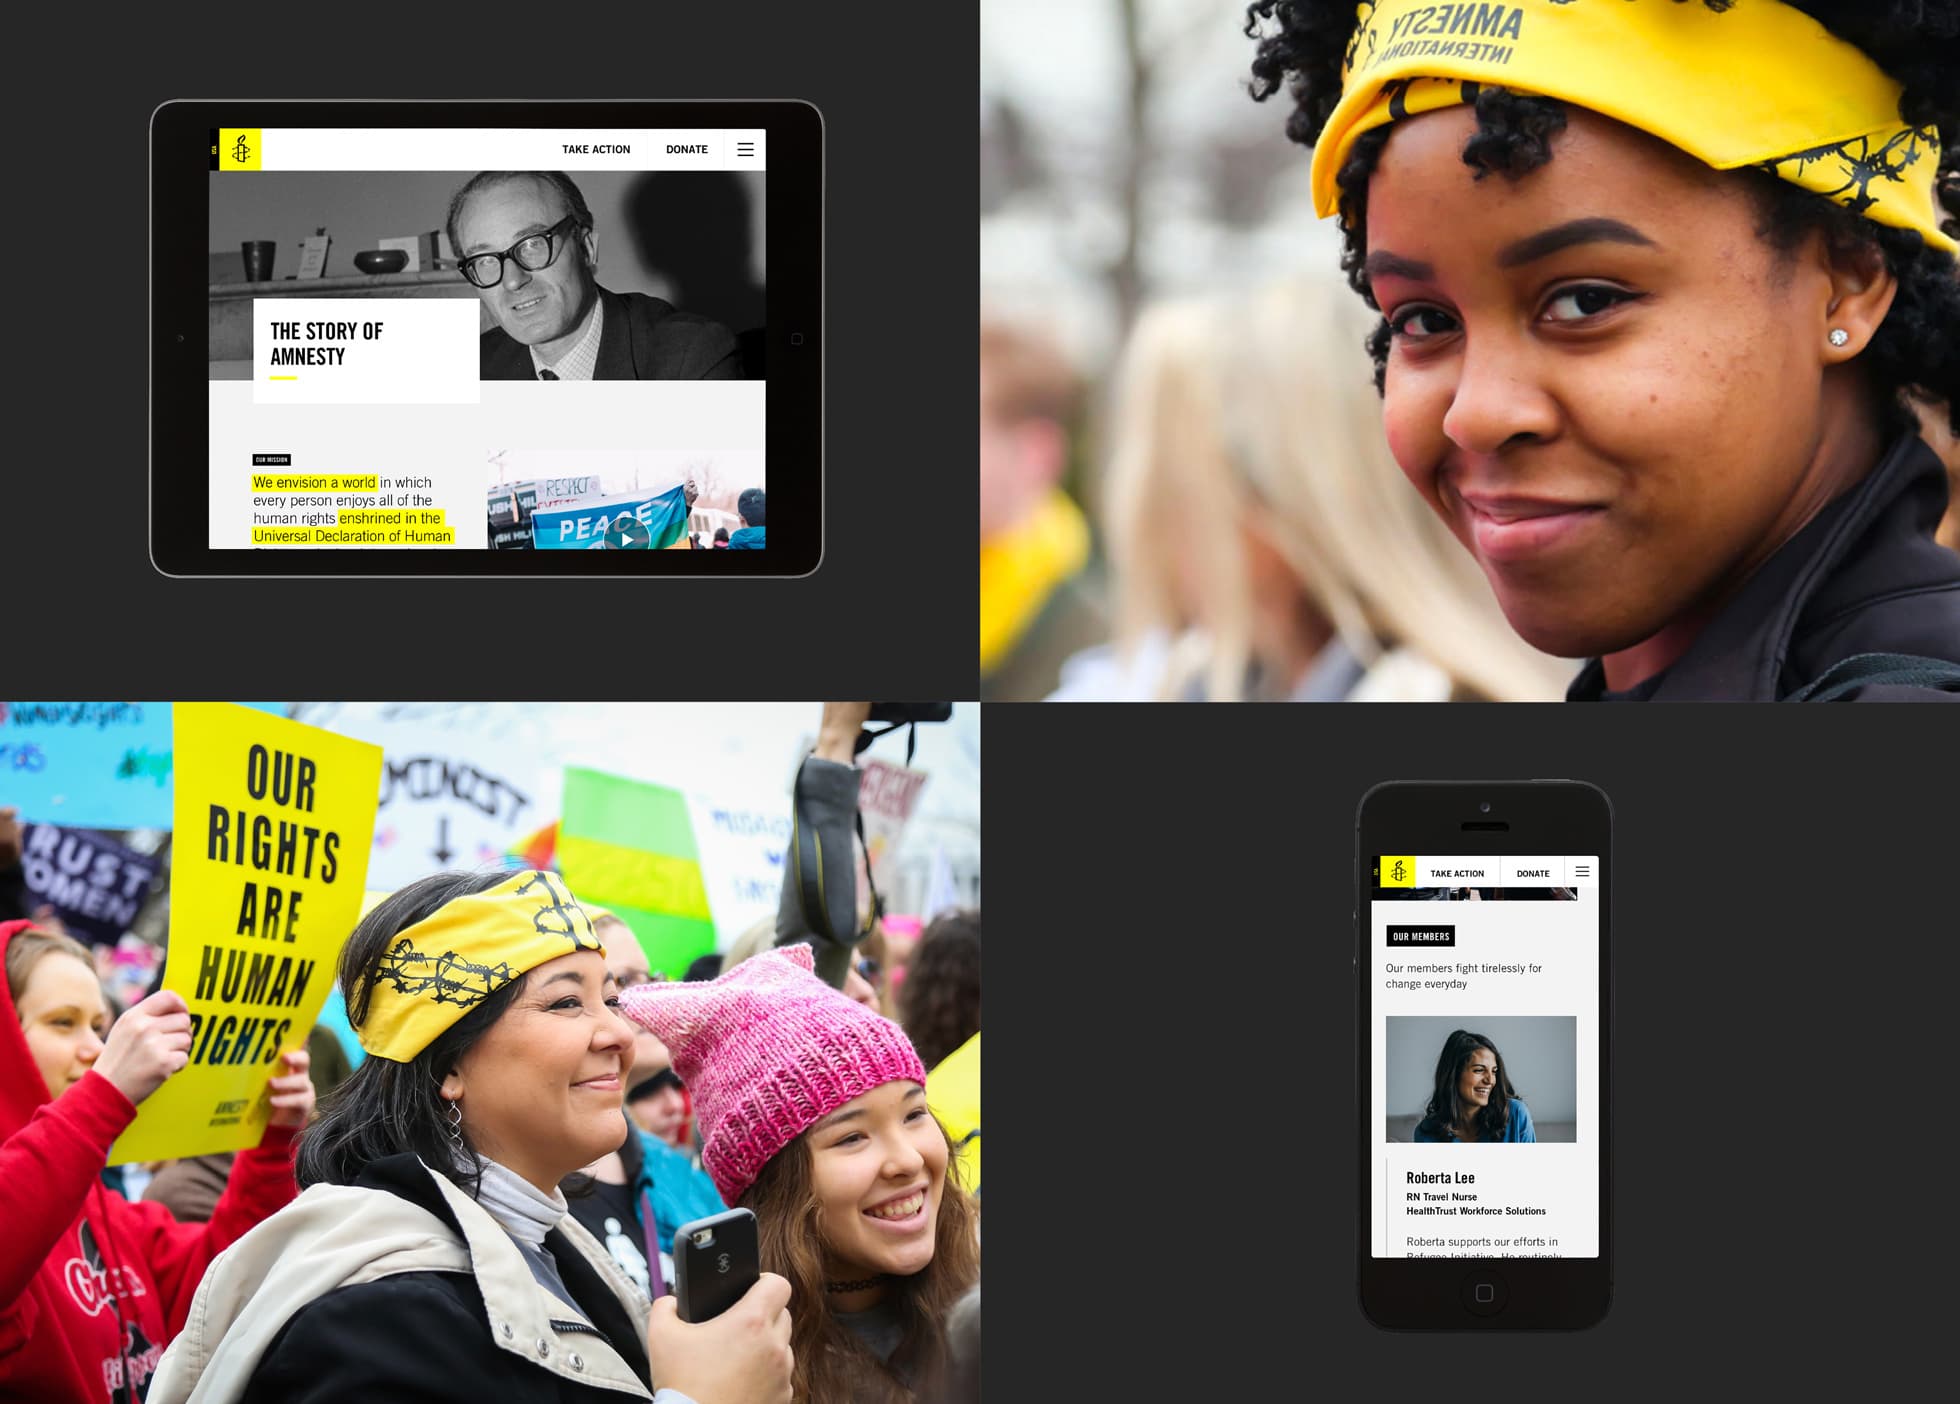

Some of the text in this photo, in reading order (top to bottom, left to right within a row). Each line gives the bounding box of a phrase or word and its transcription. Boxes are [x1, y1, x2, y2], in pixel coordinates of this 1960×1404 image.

[562, 144, 631, 154] TAKE ACTION
[666, 144, 709, 154] DONATE
[270, 321, 384, 341] THE STORY OF
[270, 346, 346, 366] AMNESTY
[253, 476, 432, 489] We envision a world in which
[546, 477, 591, 497] RESPECT
[253, 494, 433, 509] every person enjoys all of the
[488, 501, 512, 515] USH
[253, 512, 441, 527] human rights enshrined in the
[560, 502, 653, 542] PEACE
[254, 529, 451, 542] Universal Declaration of Human
[247, 743, 317, 813] OUR
[207, 803, 341, 884] RIGHTS
[27, 824, 154, 898] RUST
[1430, 869, 1485, 878] TAKE ACTION
[1516, 869, 1551, 878] DONATE
[23, 854, 138, 927] OMEN
[236, 881, 303, 944] ARE
[1393, 932, 1450, 941] OUR MEMBERS
[194, 944, 315, 1008] HUMAN
[1385, 963, 1543, 975] Our members fight tirelessly for
[1385, 978, 1468, 991] change everyday
[1406, 1171, 1476, 1185] Roberta Lee
[1406, 1192, 1478, 1202] RN Travel Nurse
[1406, 1206, 1547, 1216] HealthTrust Workforce Solutions
[1406, 1236, 1559, 1249] Roberta supports our efforts in
